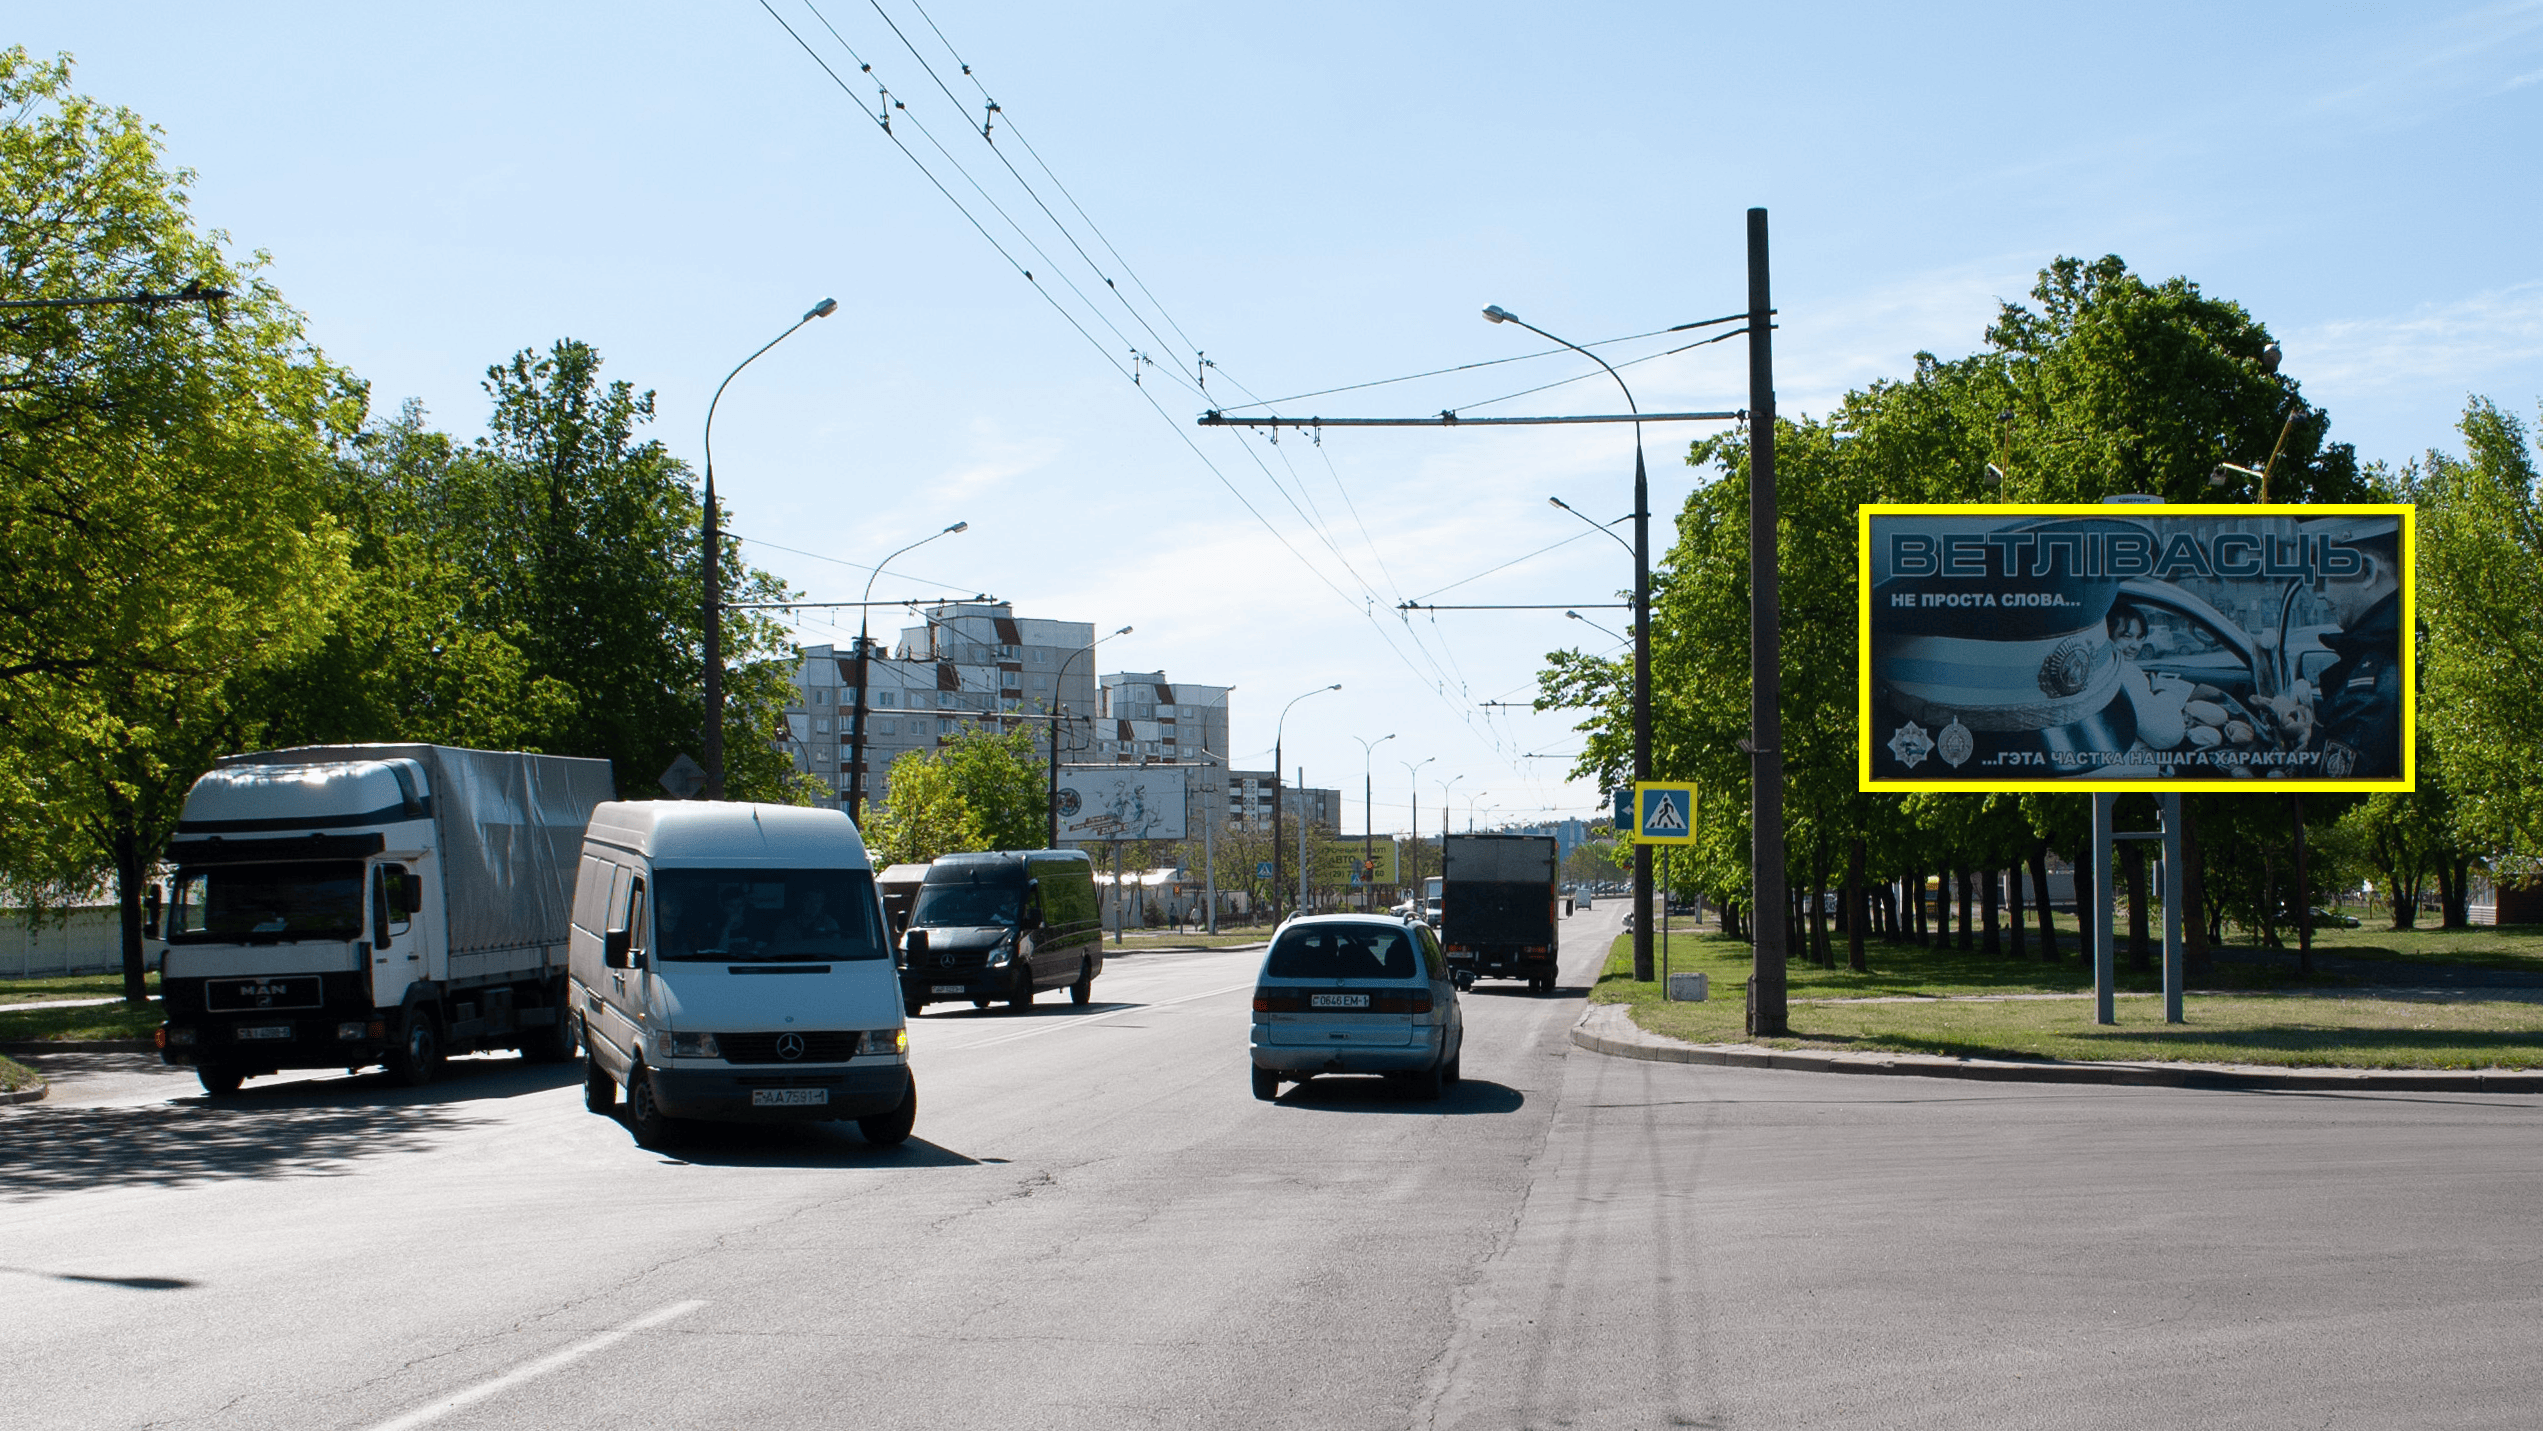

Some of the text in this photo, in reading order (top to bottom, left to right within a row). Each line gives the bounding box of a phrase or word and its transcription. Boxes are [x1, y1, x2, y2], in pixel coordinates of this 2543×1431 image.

[1889, 532, 2363, 586] ВЕТЛІВАСЦЬ
[1891, 593, 2082, 607] НЕ ПРОСТА СЛОВА...
[1981, 751, 2322, 766] ...ГЭТА ЧАСТКА НАШАГА ХАРАКТАРУ
[1330, 855, 1356, 864] АВТО
[240, 985, 287, 996] MAN
